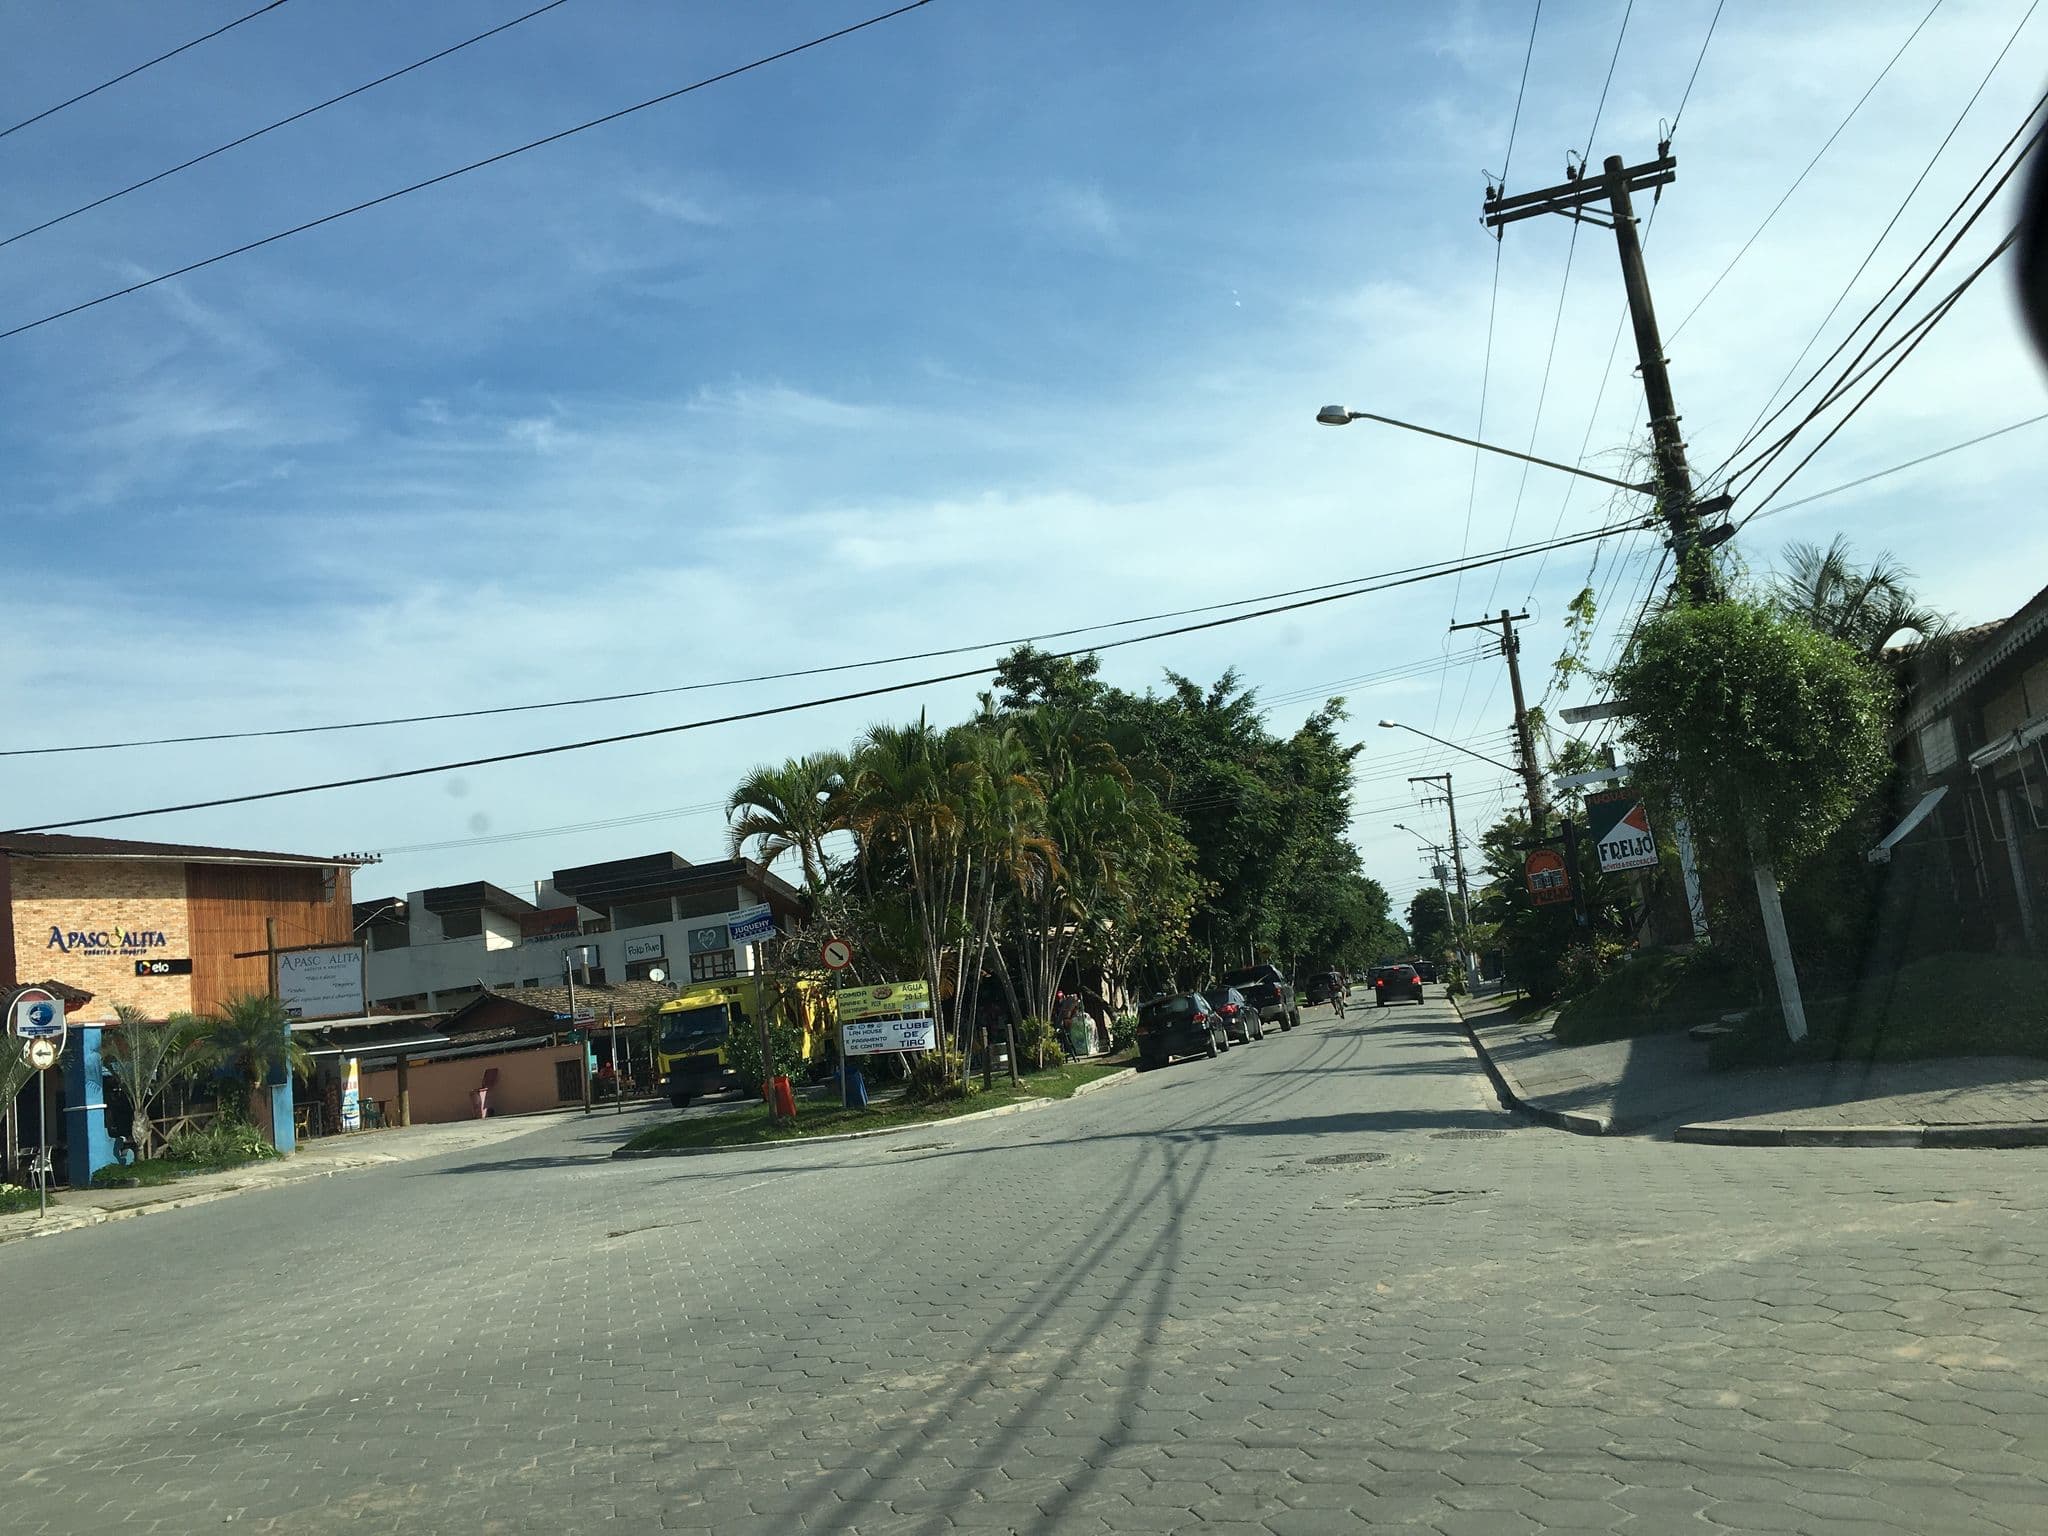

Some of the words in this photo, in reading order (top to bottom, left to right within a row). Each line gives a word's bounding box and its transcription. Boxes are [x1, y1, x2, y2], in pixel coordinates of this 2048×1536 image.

[735, 919, 769, 935] JUQUEHY
[839, 991, 867, 999] COMIDA
[892, 1021, 929, 1031] CLUBE
[899, 1038, 926, 1048] TIRO
